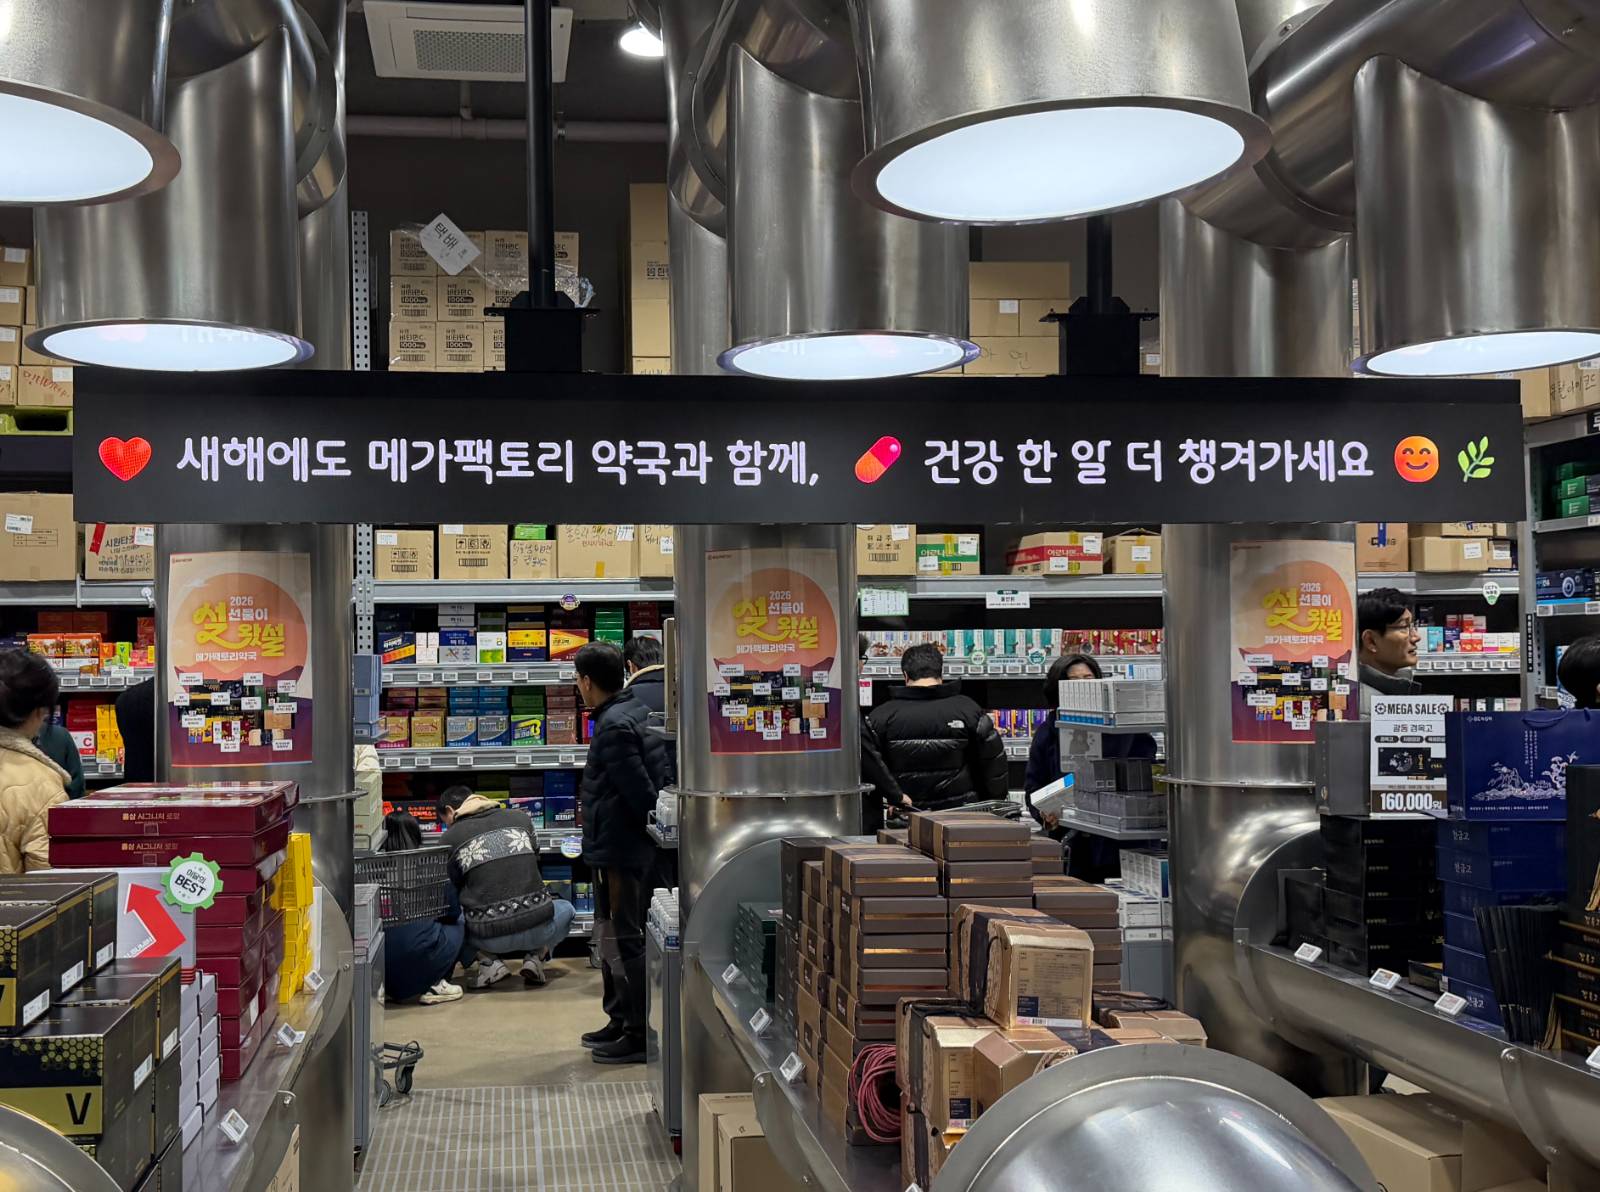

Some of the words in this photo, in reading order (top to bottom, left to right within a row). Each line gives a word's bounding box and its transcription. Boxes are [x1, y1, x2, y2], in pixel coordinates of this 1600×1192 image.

[176, 437, 352, 482] 새해에도
[368, 438, 574, 485] 메가팩토리
[592, 440, 713, 486] 약국과
[727, 440, 819, 487] 함께,
[924, 439, 1003, 484] 건강
[1017, 439, 1057, 484] 한
[1072, 440, 1111, 484] 알
[1128, 440, 1162, 483] 더
[1179, 438, 1374, 484] 챙겨가세요
[1300, 583, 1320, 592] 2026
[230, 596, 254, 606] 2026
[769, 591, 792, 601] 2026
[1300, 594, 1331, 606] 선물이
[229, 608, 268, 621] 선물이
[768, 602, 804, 614] 선물이
[1387, 703, 1413, 715] MEGA
[1414, 703, 1438, 715] SALE
[1380, 792, 1442, 811] 160,000원
[186, 869, 206, 884] 이달의
[175, 874, 206, 896] BEST
[65, 1092, 92, 1125] V
